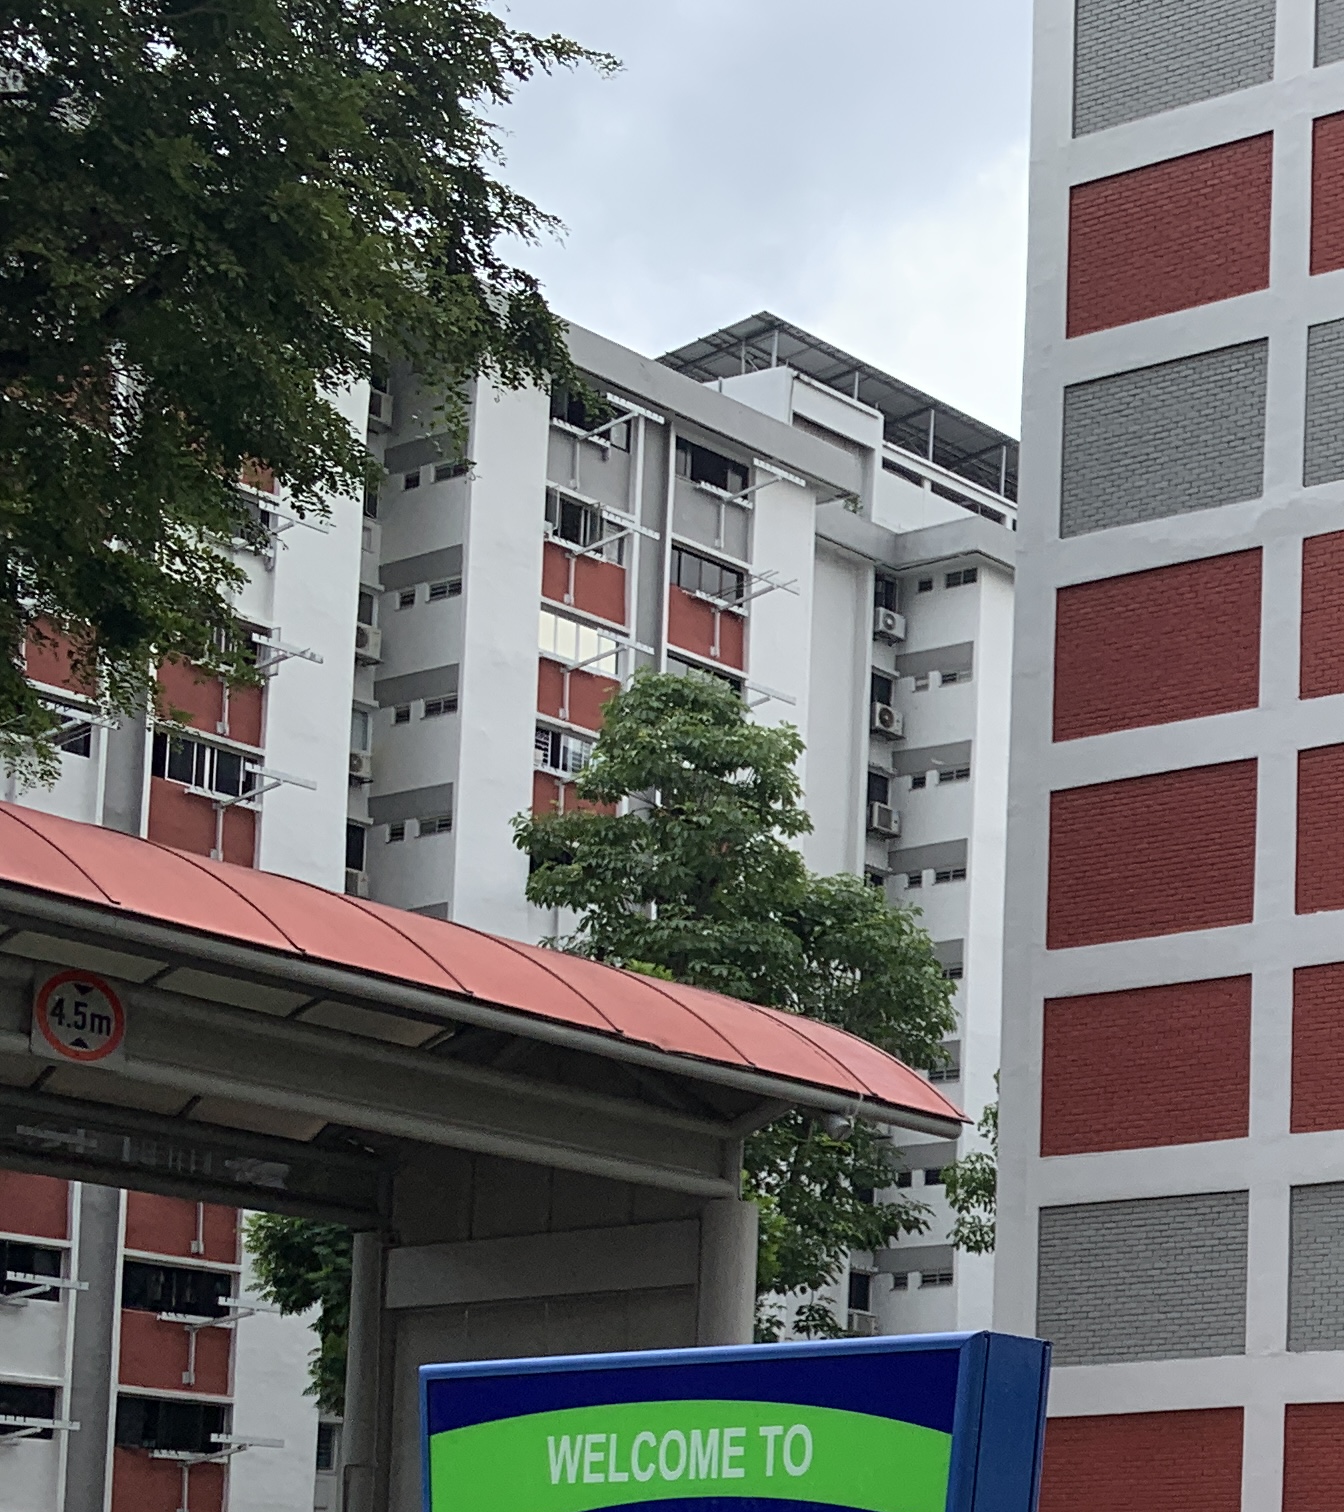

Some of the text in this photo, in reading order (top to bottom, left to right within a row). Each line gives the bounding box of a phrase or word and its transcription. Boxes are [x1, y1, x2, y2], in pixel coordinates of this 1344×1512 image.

[50, 997, 111, 1036] 4.5m
[547, 1424, 813, 1484] WELCOME TO
